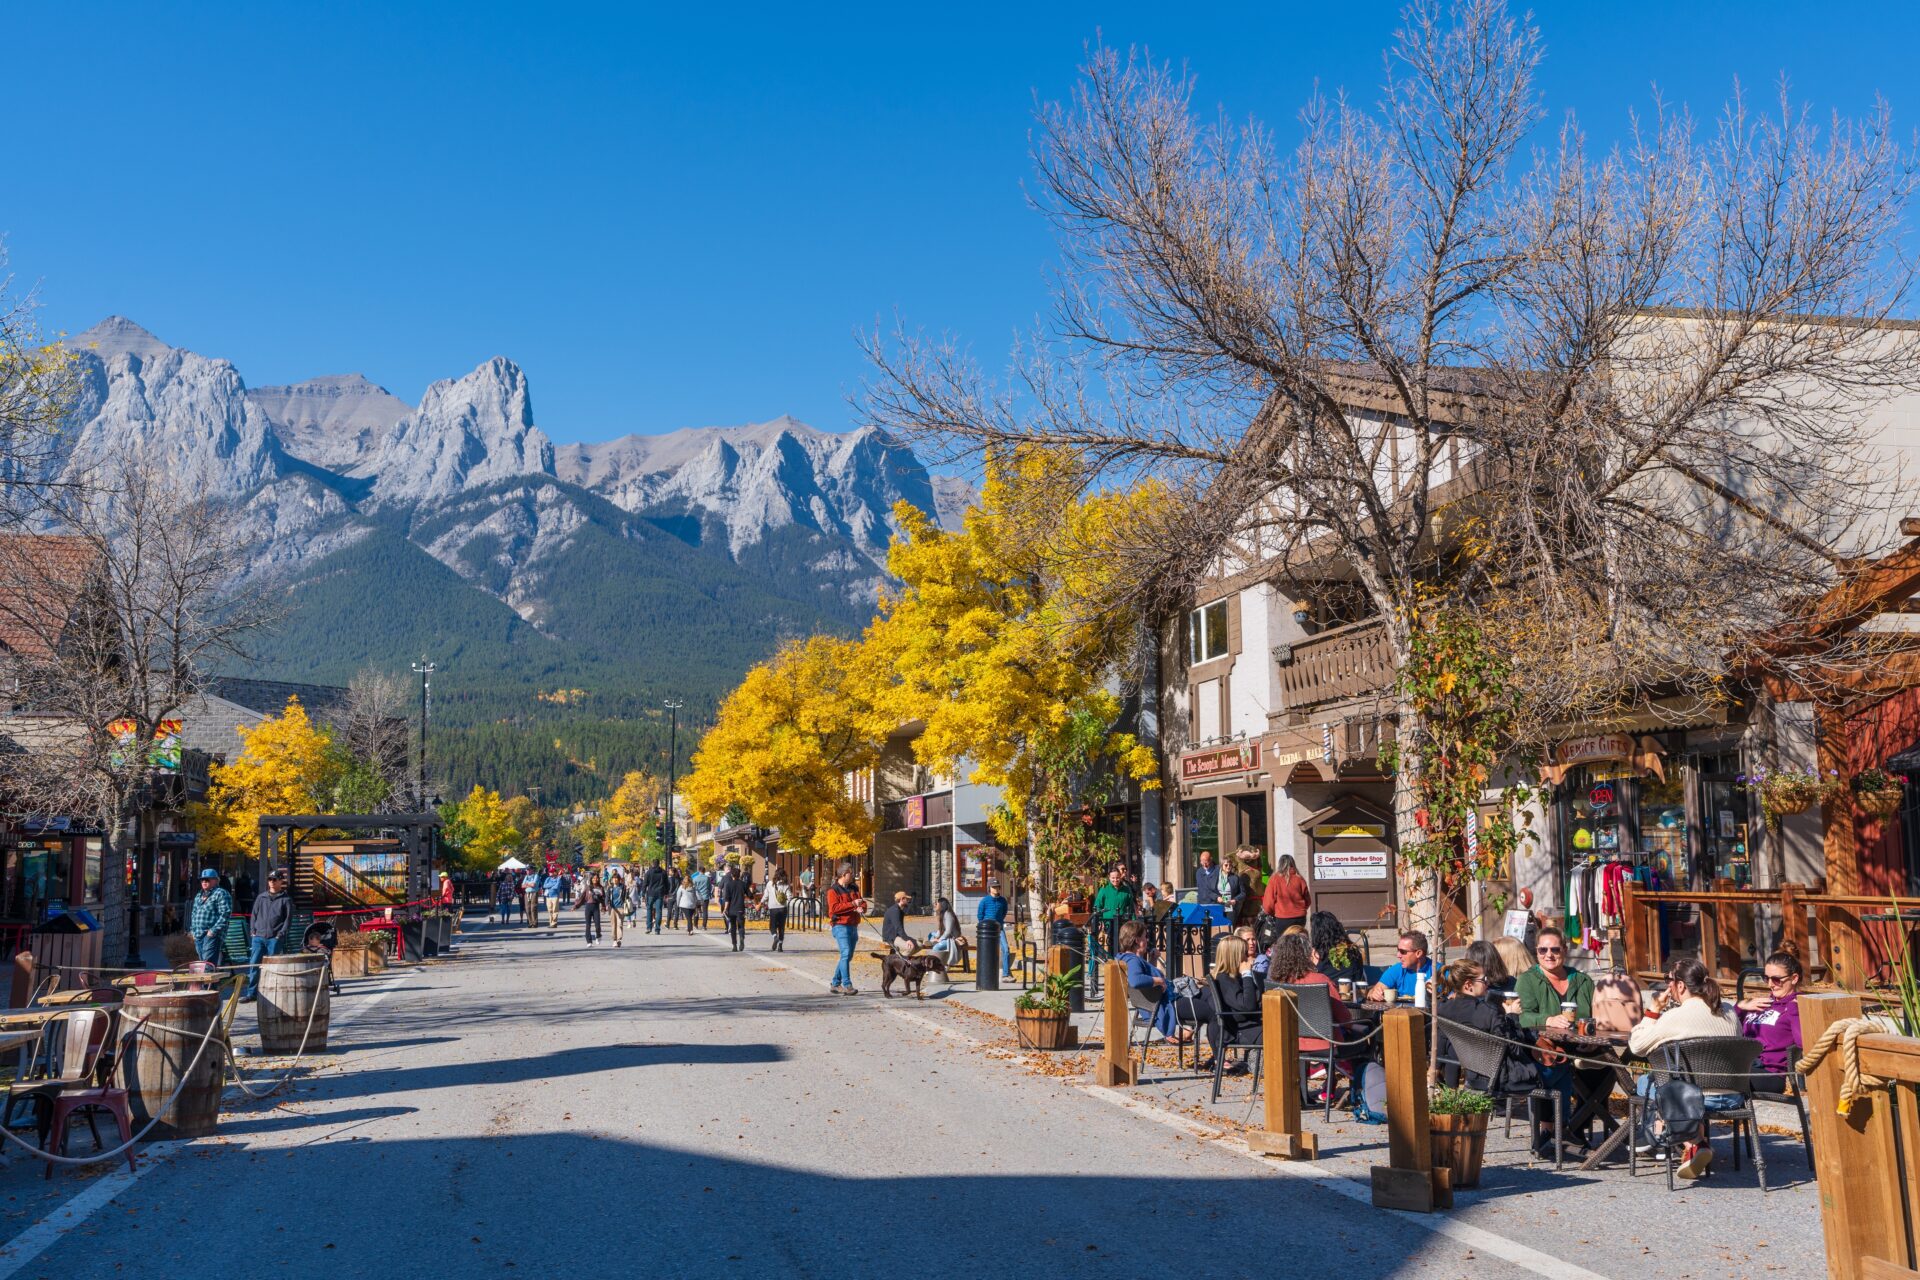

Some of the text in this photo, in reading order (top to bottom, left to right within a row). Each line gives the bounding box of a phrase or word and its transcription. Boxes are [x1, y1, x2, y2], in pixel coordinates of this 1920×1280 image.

[1561, 736, 1629, 758] VENICE GIFTS
[1186, 759, 1197, 774] The
[1589, 789, 1614, 803] OPEN
[17, 841, 36, 849] open
[1369, 855, 1384, 863] Shop
